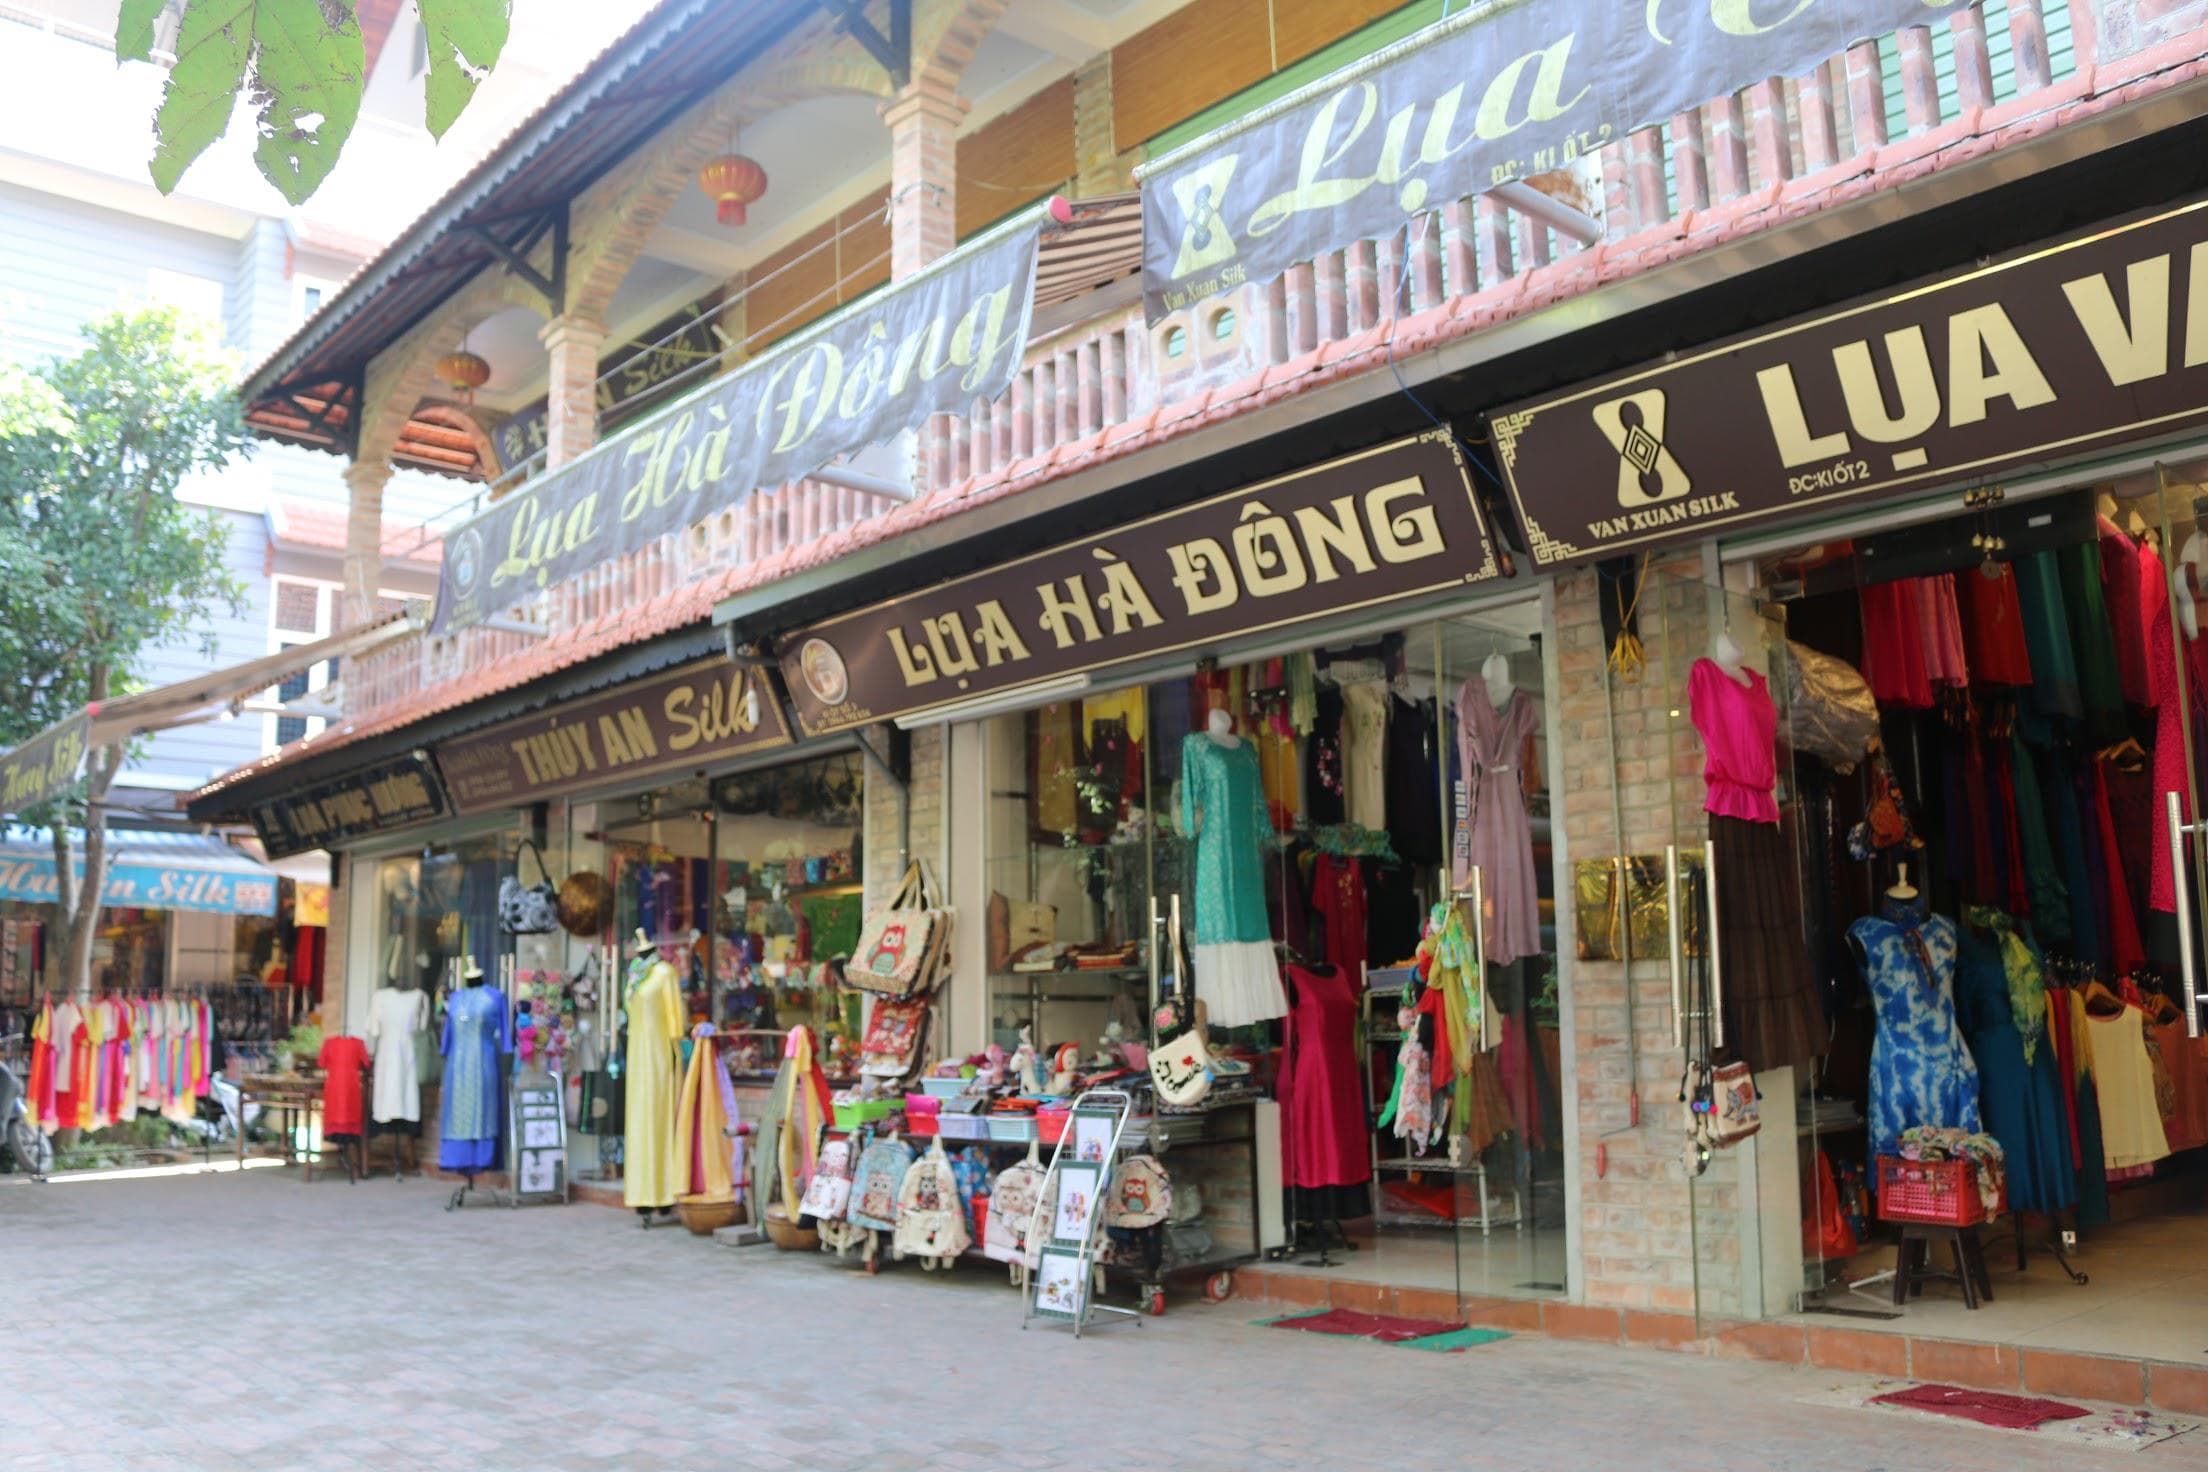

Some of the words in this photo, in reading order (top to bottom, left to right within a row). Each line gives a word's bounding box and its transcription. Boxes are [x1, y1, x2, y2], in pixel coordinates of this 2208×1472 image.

[1247, 32, 1592, 238] Lụa
[1221, 262, 1246, 288] Silk
[491, 491, 600, 588] Lụa
[620, 405, 733, 523] Hà
[756, 284, 1018, 455] Đông
[1757, 301, 2059, 471] LỤA
[886, 599, 1031, 690] LỤA
[1036, 547, 1165, 650] HÀ
[1165, 474, 1447, 617] ĐÔNG
[1588, 515, 1631, 539] VAN
[1631, 503, 1688, 528] XUAN
[1689, 491, 1740, 517] SILK
[597, 705, 658, 768] AN
[663, 668, 760, 752] Silk
[148, 871, 230, 906] Silk
